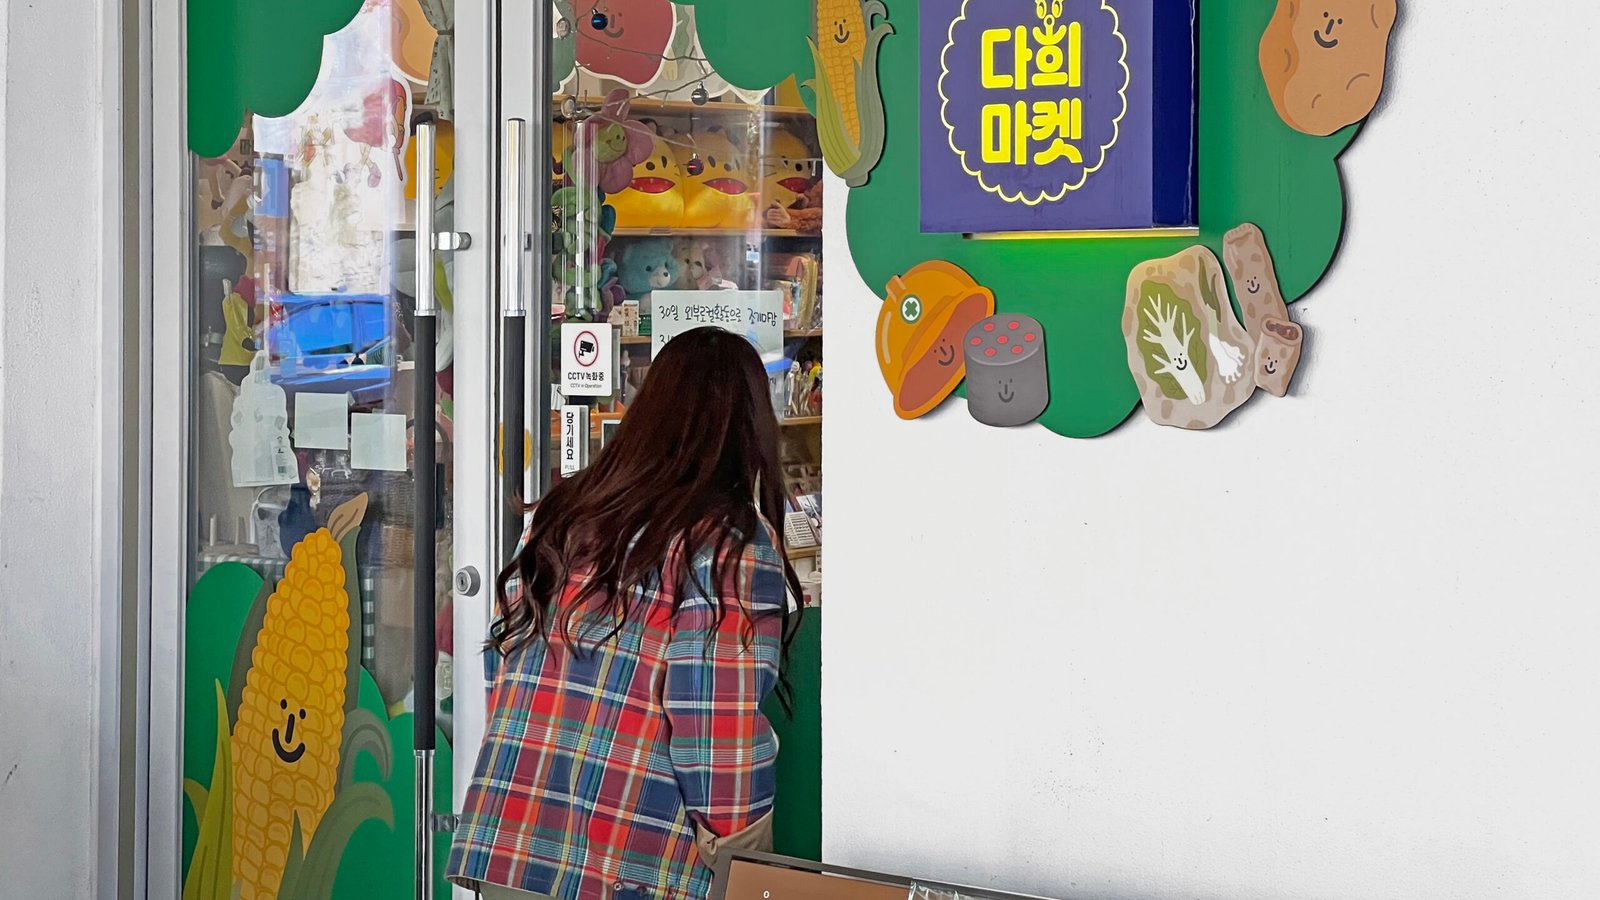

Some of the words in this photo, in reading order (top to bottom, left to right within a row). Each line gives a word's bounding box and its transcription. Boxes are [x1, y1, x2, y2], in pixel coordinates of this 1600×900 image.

[981, 14, 1082, 90] 다희
[981, 97, 1083, 166] 마켓
[658, 304, 679, 321] 30일
[747, 307, 778, 327] 조기마감
[566, 411, 575, 460] 당기세요
